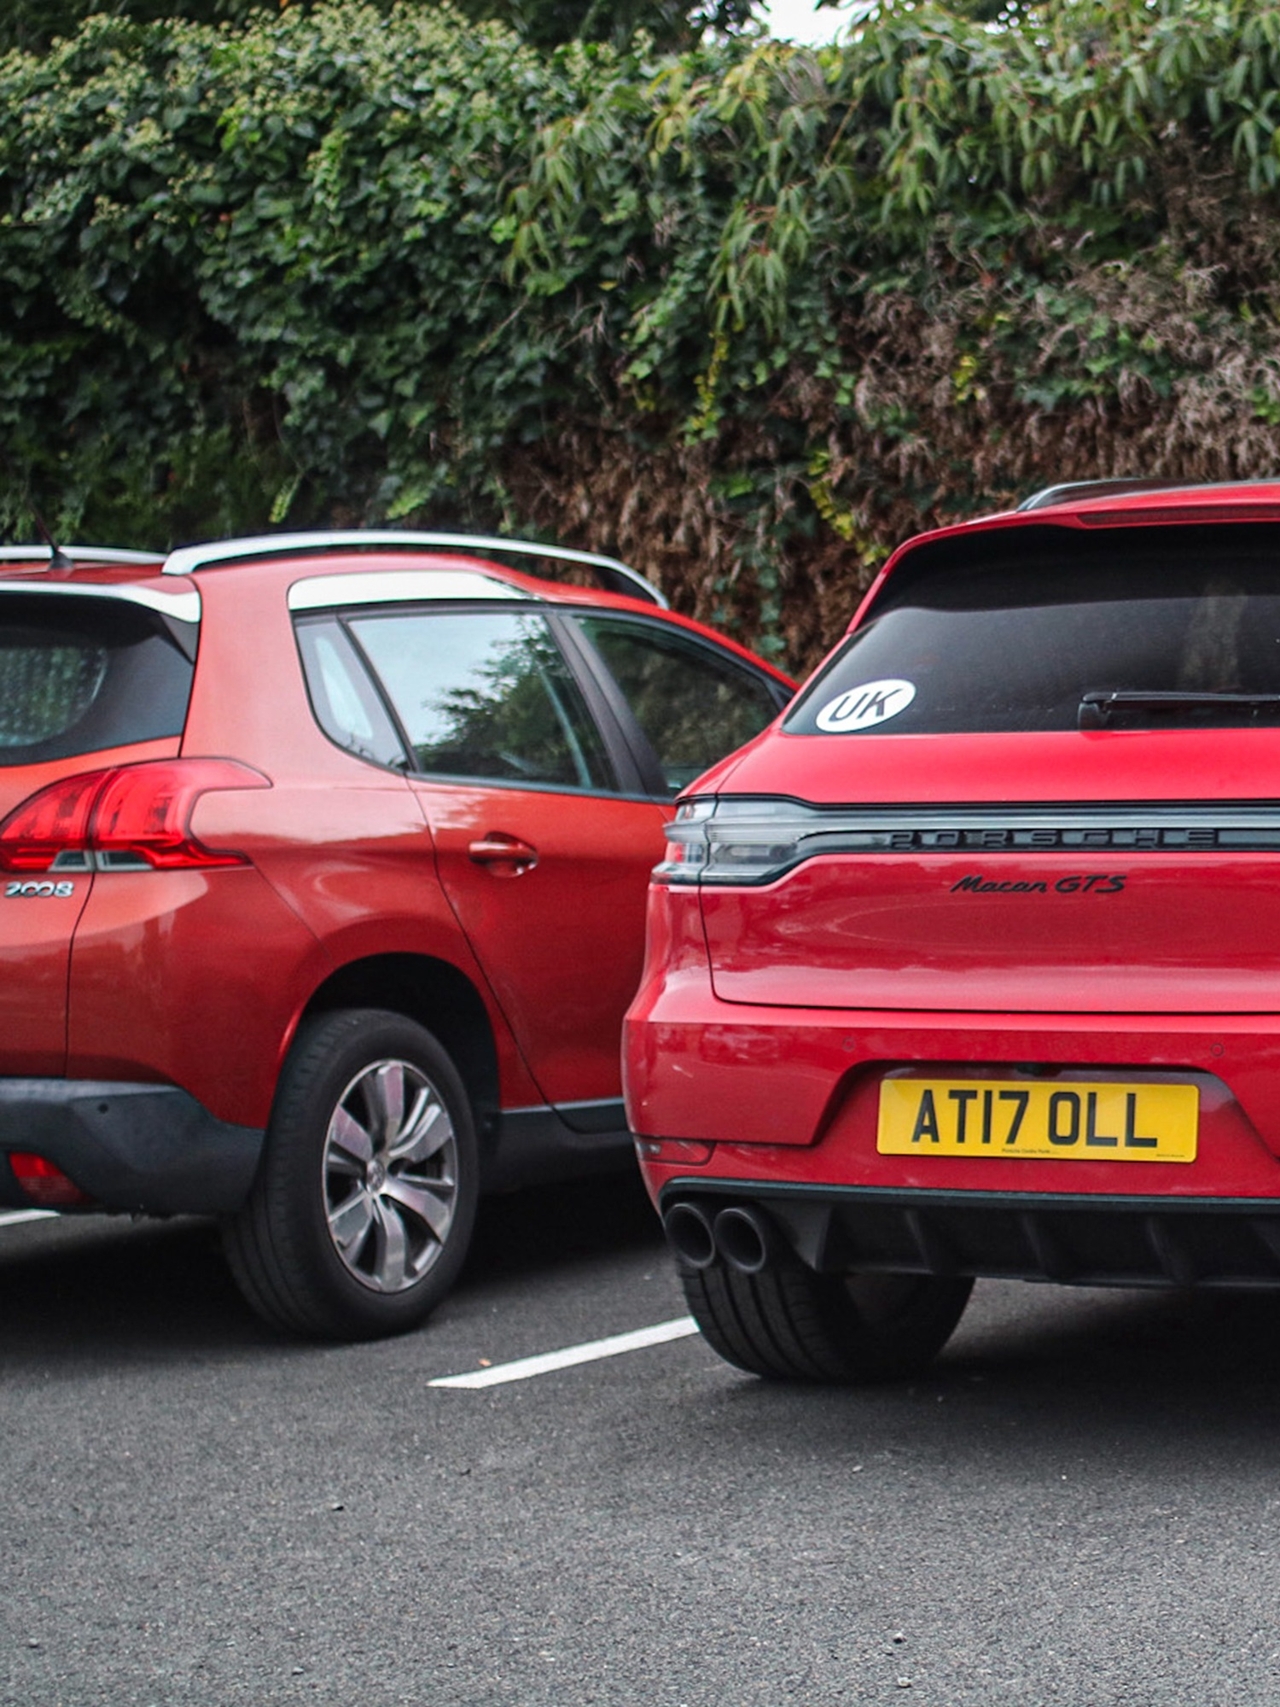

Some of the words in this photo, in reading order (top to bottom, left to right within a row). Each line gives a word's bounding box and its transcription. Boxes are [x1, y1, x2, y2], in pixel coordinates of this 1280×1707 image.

[828, 688, 904, 722] UK
[886, 829, 1217, 850] PORSCHE
[4, 881, 75, 897] 2008
[950, 875, 1048, 894] Macan
[1054, 875, 1128, 894] GTS
[911, 1089, 1030, 1144] AT17
[1048, 1091, 1158, 1148] OLL
